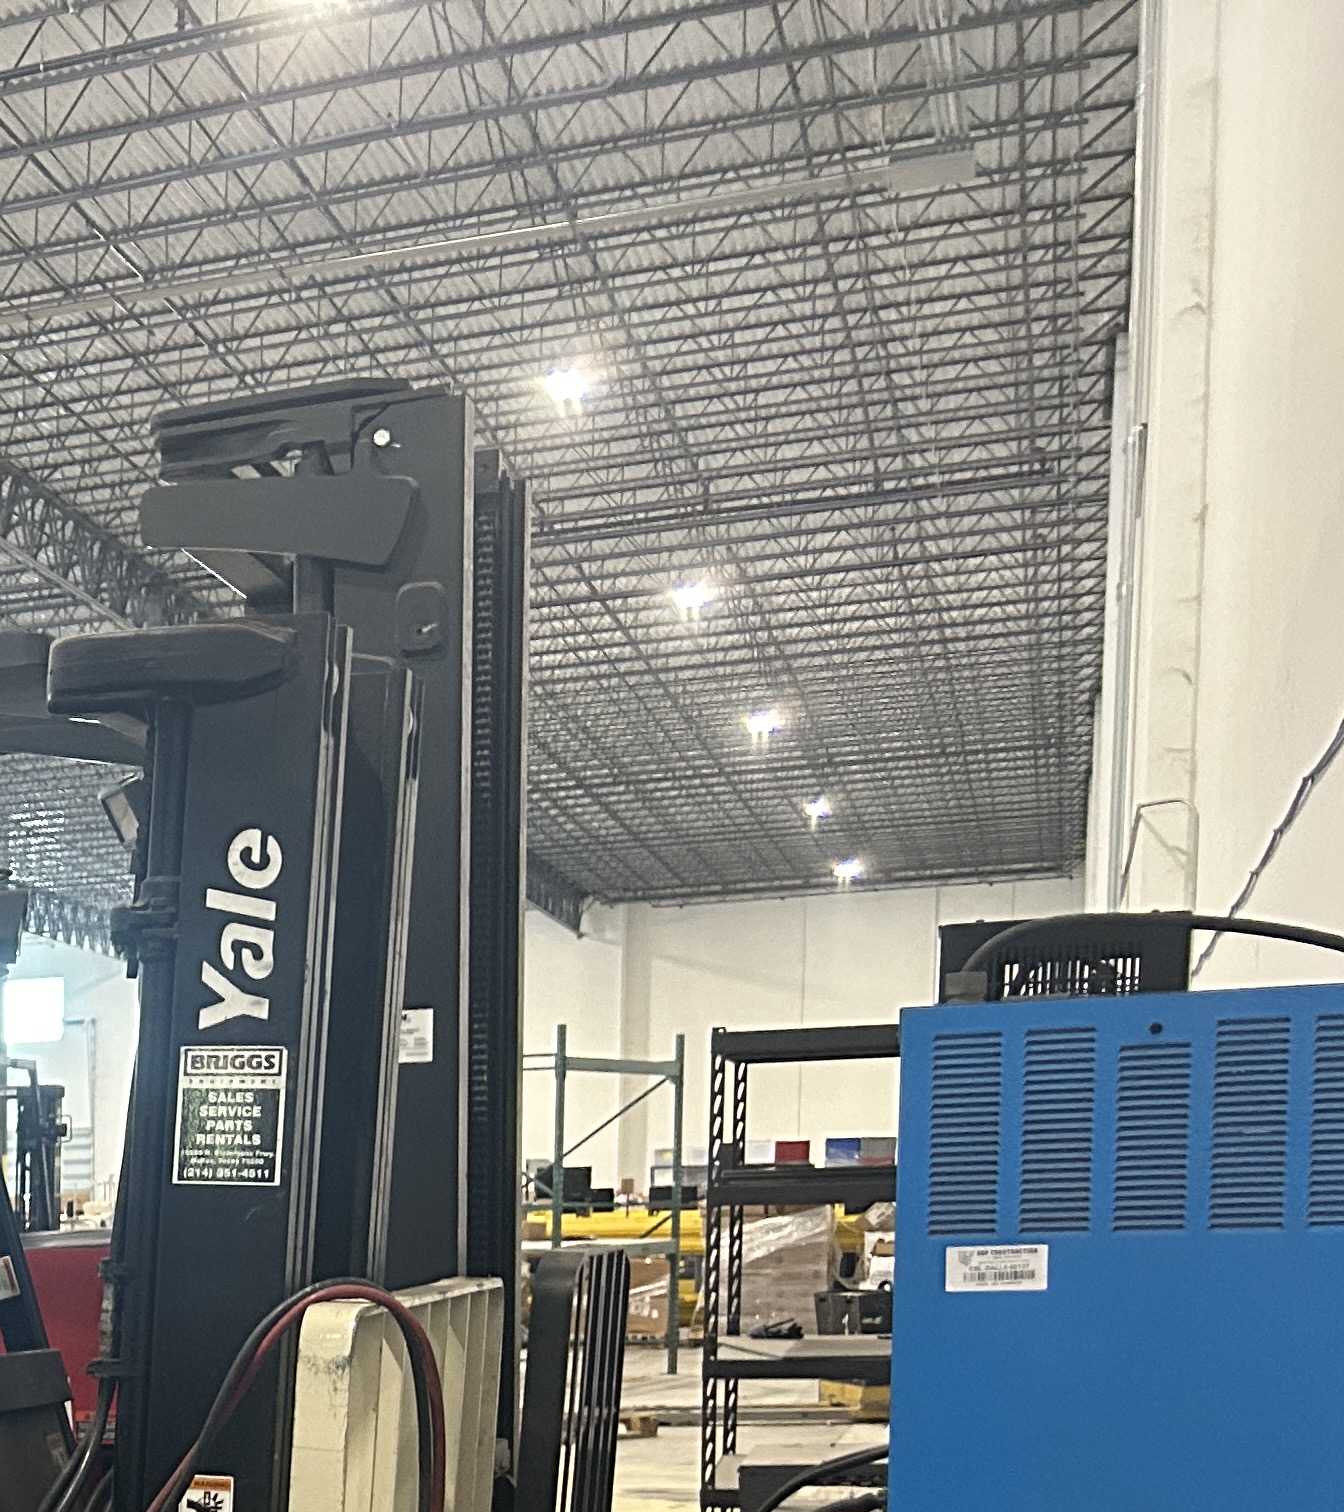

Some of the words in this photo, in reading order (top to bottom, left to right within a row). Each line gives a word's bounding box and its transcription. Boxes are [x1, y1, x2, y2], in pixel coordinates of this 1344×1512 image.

[198, 828, 284, 1030] Yale
[191, 1054, 275, 1070] BRIGGS
[208, 1092, 254, 1103] SALES
[199, 1105, 262, 1117] SERVICE
[205, 1120, 253, 1131] PARTS
[195, 1133, 262, 1145] RENTALS
[183, 1168, 213, 1178] (214)
